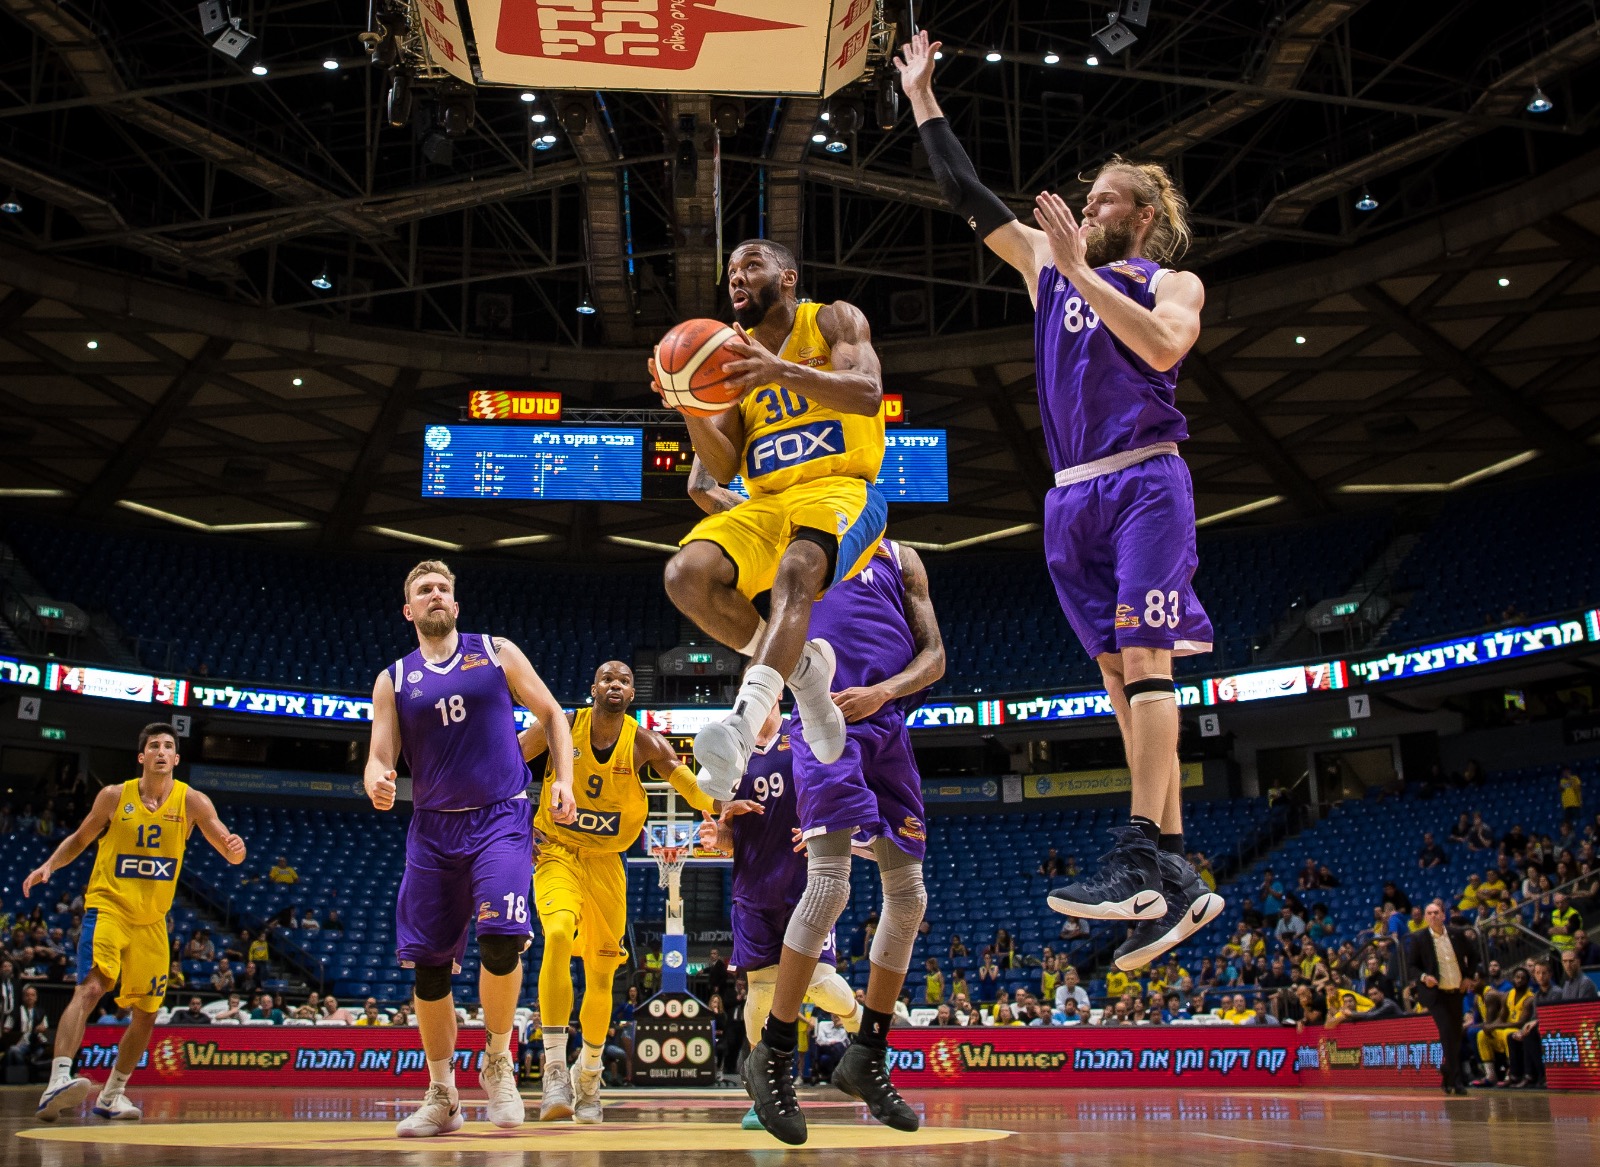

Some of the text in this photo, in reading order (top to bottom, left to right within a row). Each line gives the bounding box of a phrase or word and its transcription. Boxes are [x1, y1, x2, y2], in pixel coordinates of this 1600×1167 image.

[1064, 297, 1100, 333] 83
[512, 397, 560, 415] טוטו
[756, 387, 809, 425] 30
[601, 435, 635, 447] מכבי
[754, 427, 837, 470] FOX
[1144, 589, 1180, 629] 83
[63, 667, 81, 691] 4
[1309, 664, 1325, 689] 7
[155, 680, 171, 701] 5
[1218, 677, 1235, 701] 6
[23, 701, 34, 715] 4
[312, 695, 374, 720] רצ'לו
[434, 694, 467, 727] 18
[1355, 699, 1364, 713] 7
[176, 719, 185, 733] 5
[652, 710, 668, 732] 5
[1204, 718, 1214, 732] 6
[585, 774, 604, 798] 9
[753, 772, 784, 801] 99
[135, 824, 162, 848] 12
[121, 858, 173, 877] FOX
[503, 891, 528, 924] 18
[146, 974, 167, 997] 12
[654, 1004, 693, 1013] B B B
[187, 1043, 289, 1067] Winner
[360, 1050, 391, 1069] את
[645, 1044, 703, 1057] B B B
[962, 1045, 1066, 1069] Winner
[1139, 1049, 1170, 1069] את
[1175, 1049, 1204, 1074] ותן
[1208, 1049, 1251, 1074] דקה
[1256, 1049, 1286, 1074] קח
[650, 1068, 697, 1078] QUALITY TIME
